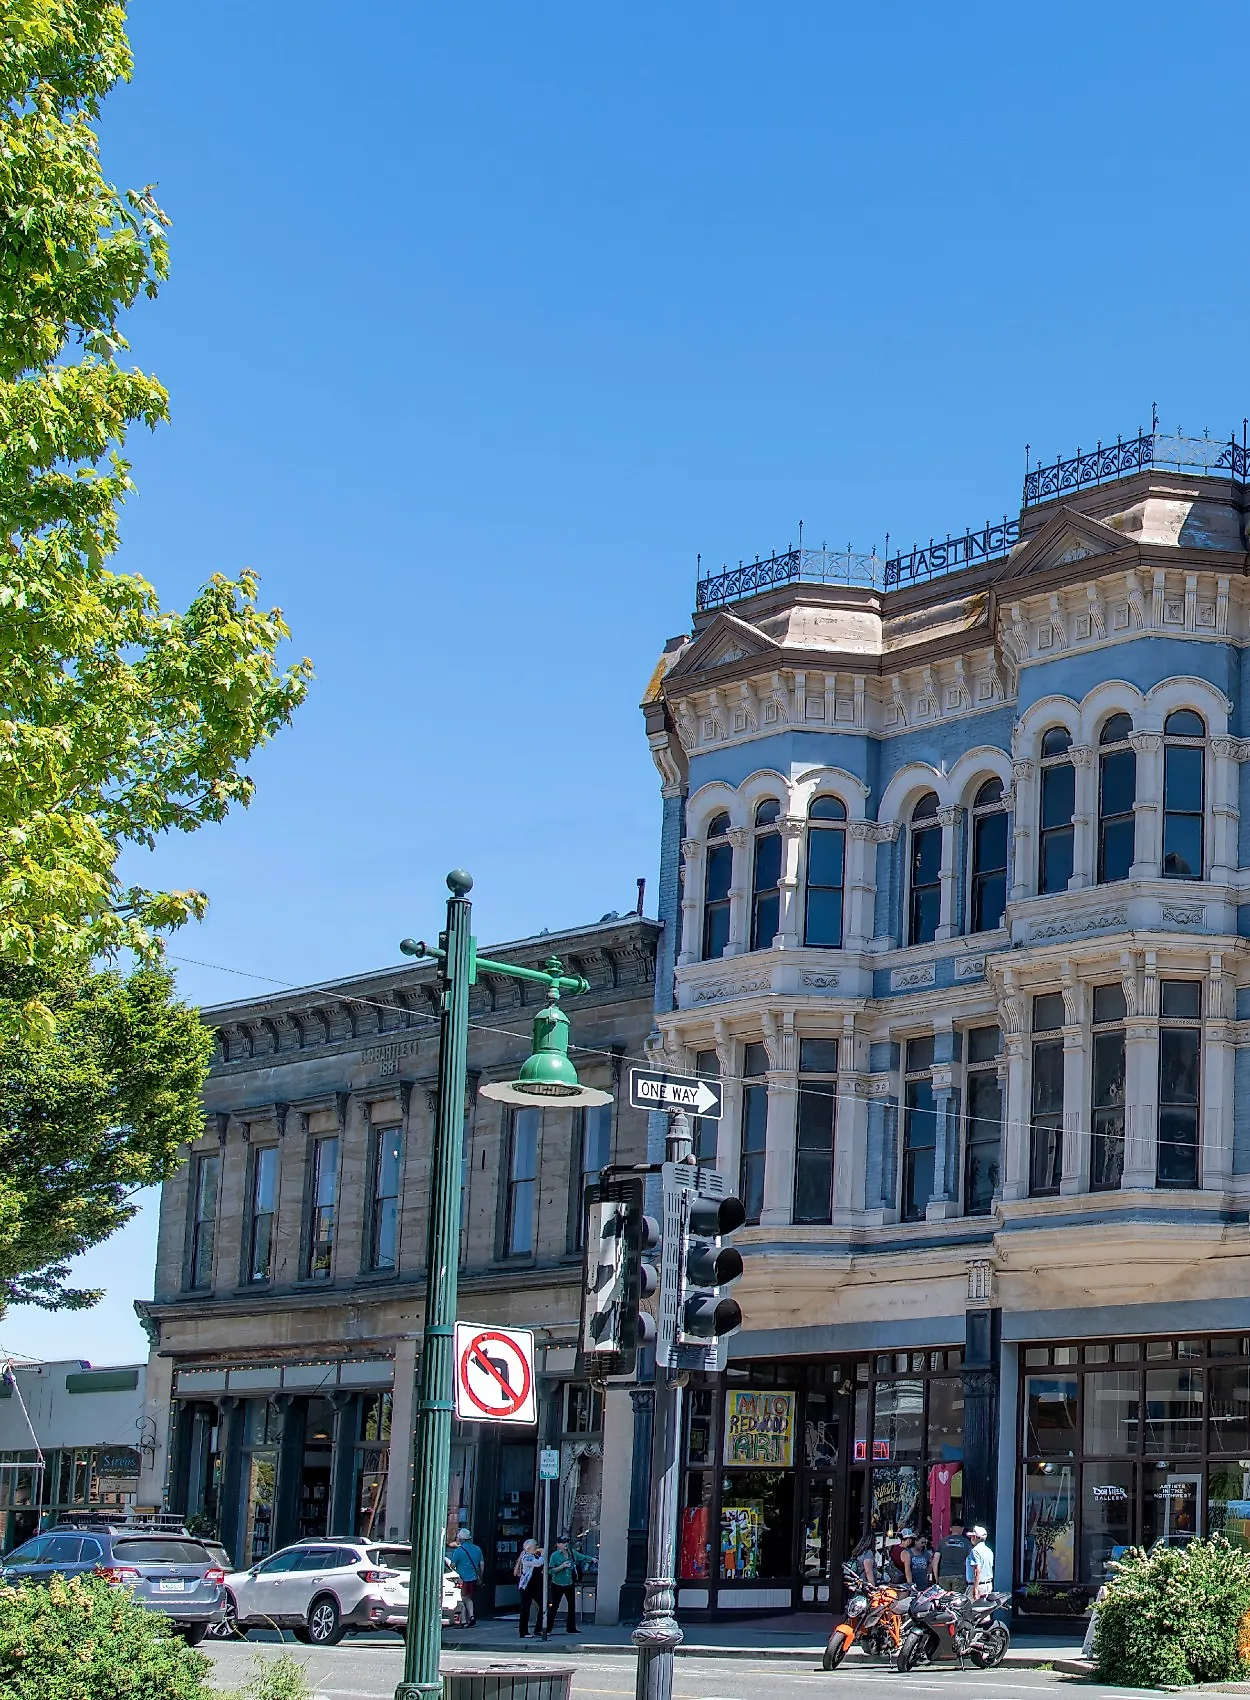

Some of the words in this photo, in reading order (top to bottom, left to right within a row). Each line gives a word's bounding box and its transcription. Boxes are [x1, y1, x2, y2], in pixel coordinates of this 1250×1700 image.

[897, 522, 1020, 578] HASTINGS
[641, 1082, 667, 1099] ONE
[672, 1086, 698, 1104] WAY
[739, 1395, 788, 1417] MILO
[730, 1415, 789, 1434] REDWOOD
[730, 1433, 788, 1462] ART
[856, 1441, 889, 1459] OEN
